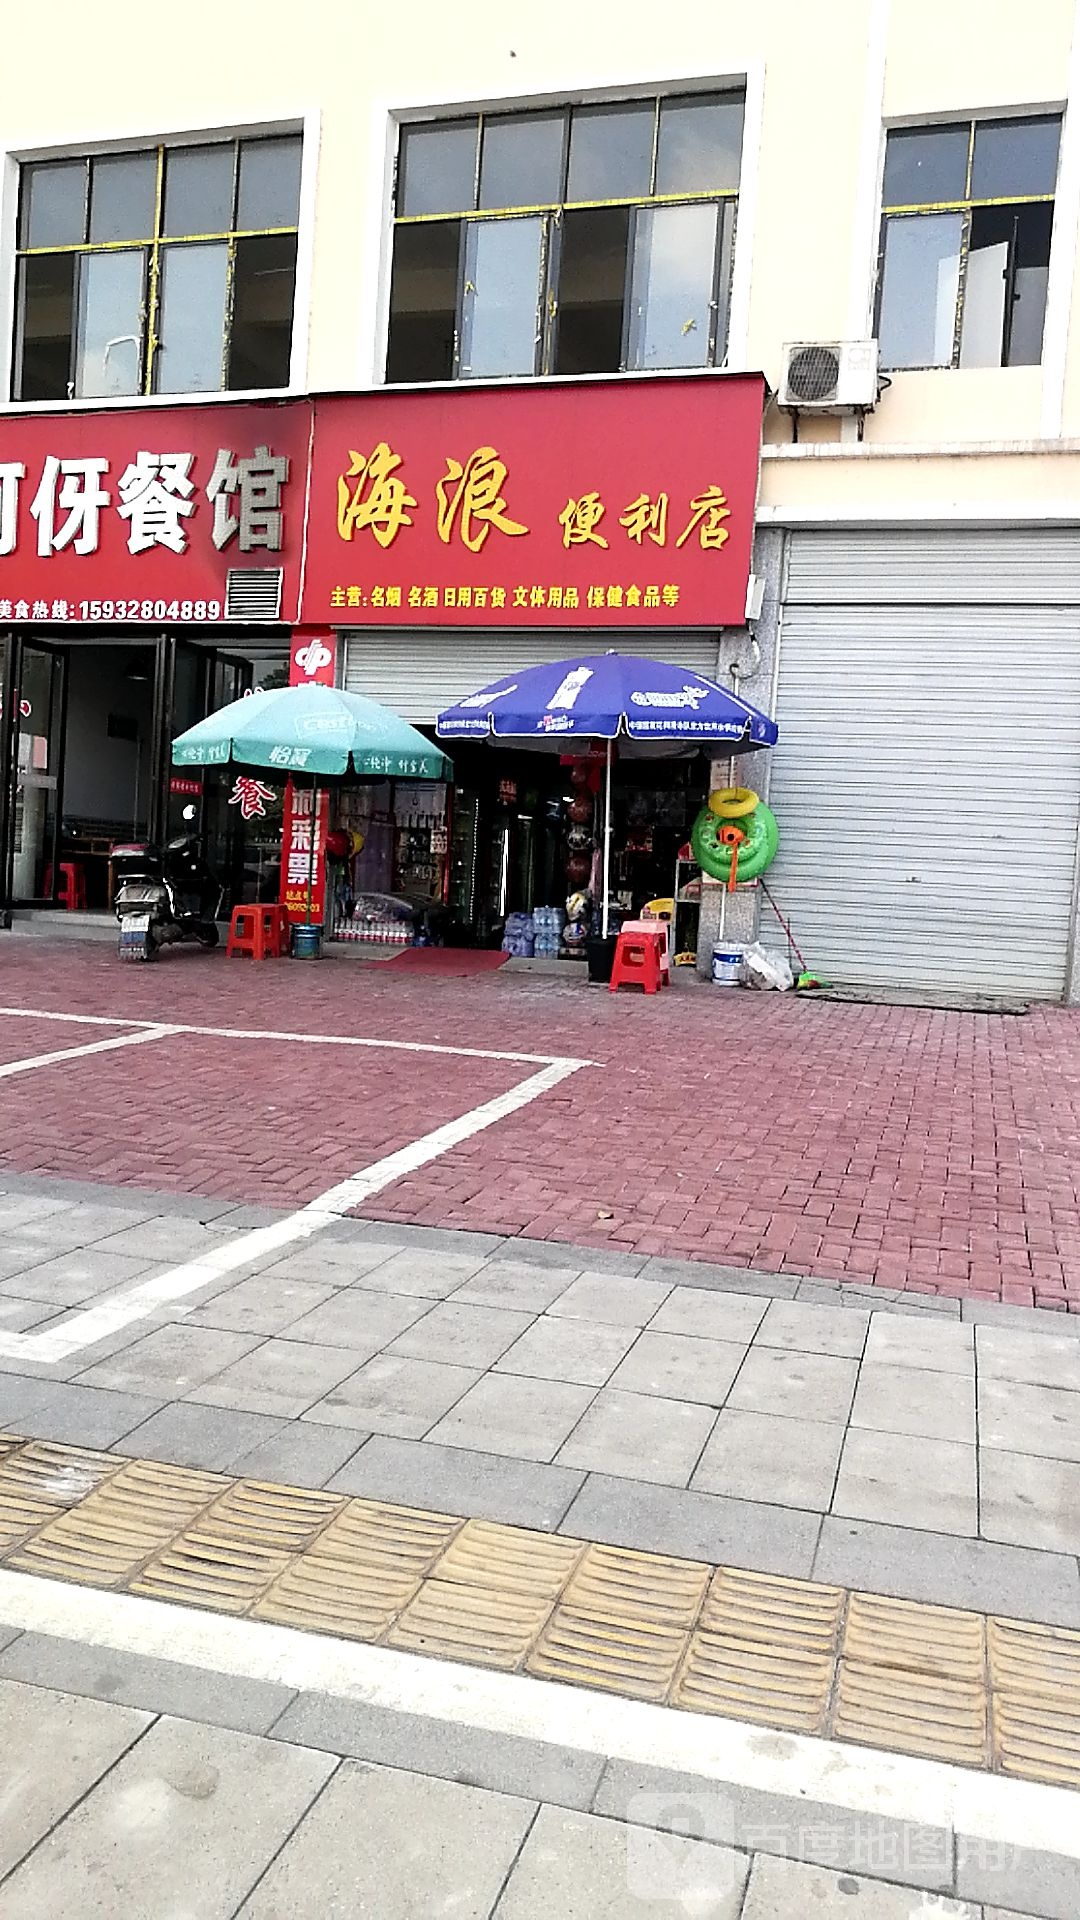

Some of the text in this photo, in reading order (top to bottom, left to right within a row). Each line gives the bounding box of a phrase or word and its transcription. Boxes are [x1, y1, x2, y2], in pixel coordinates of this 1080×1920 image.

[336, 442, 731, 552] 海浪 便利店
[228, 776, 276, 819] 餐
